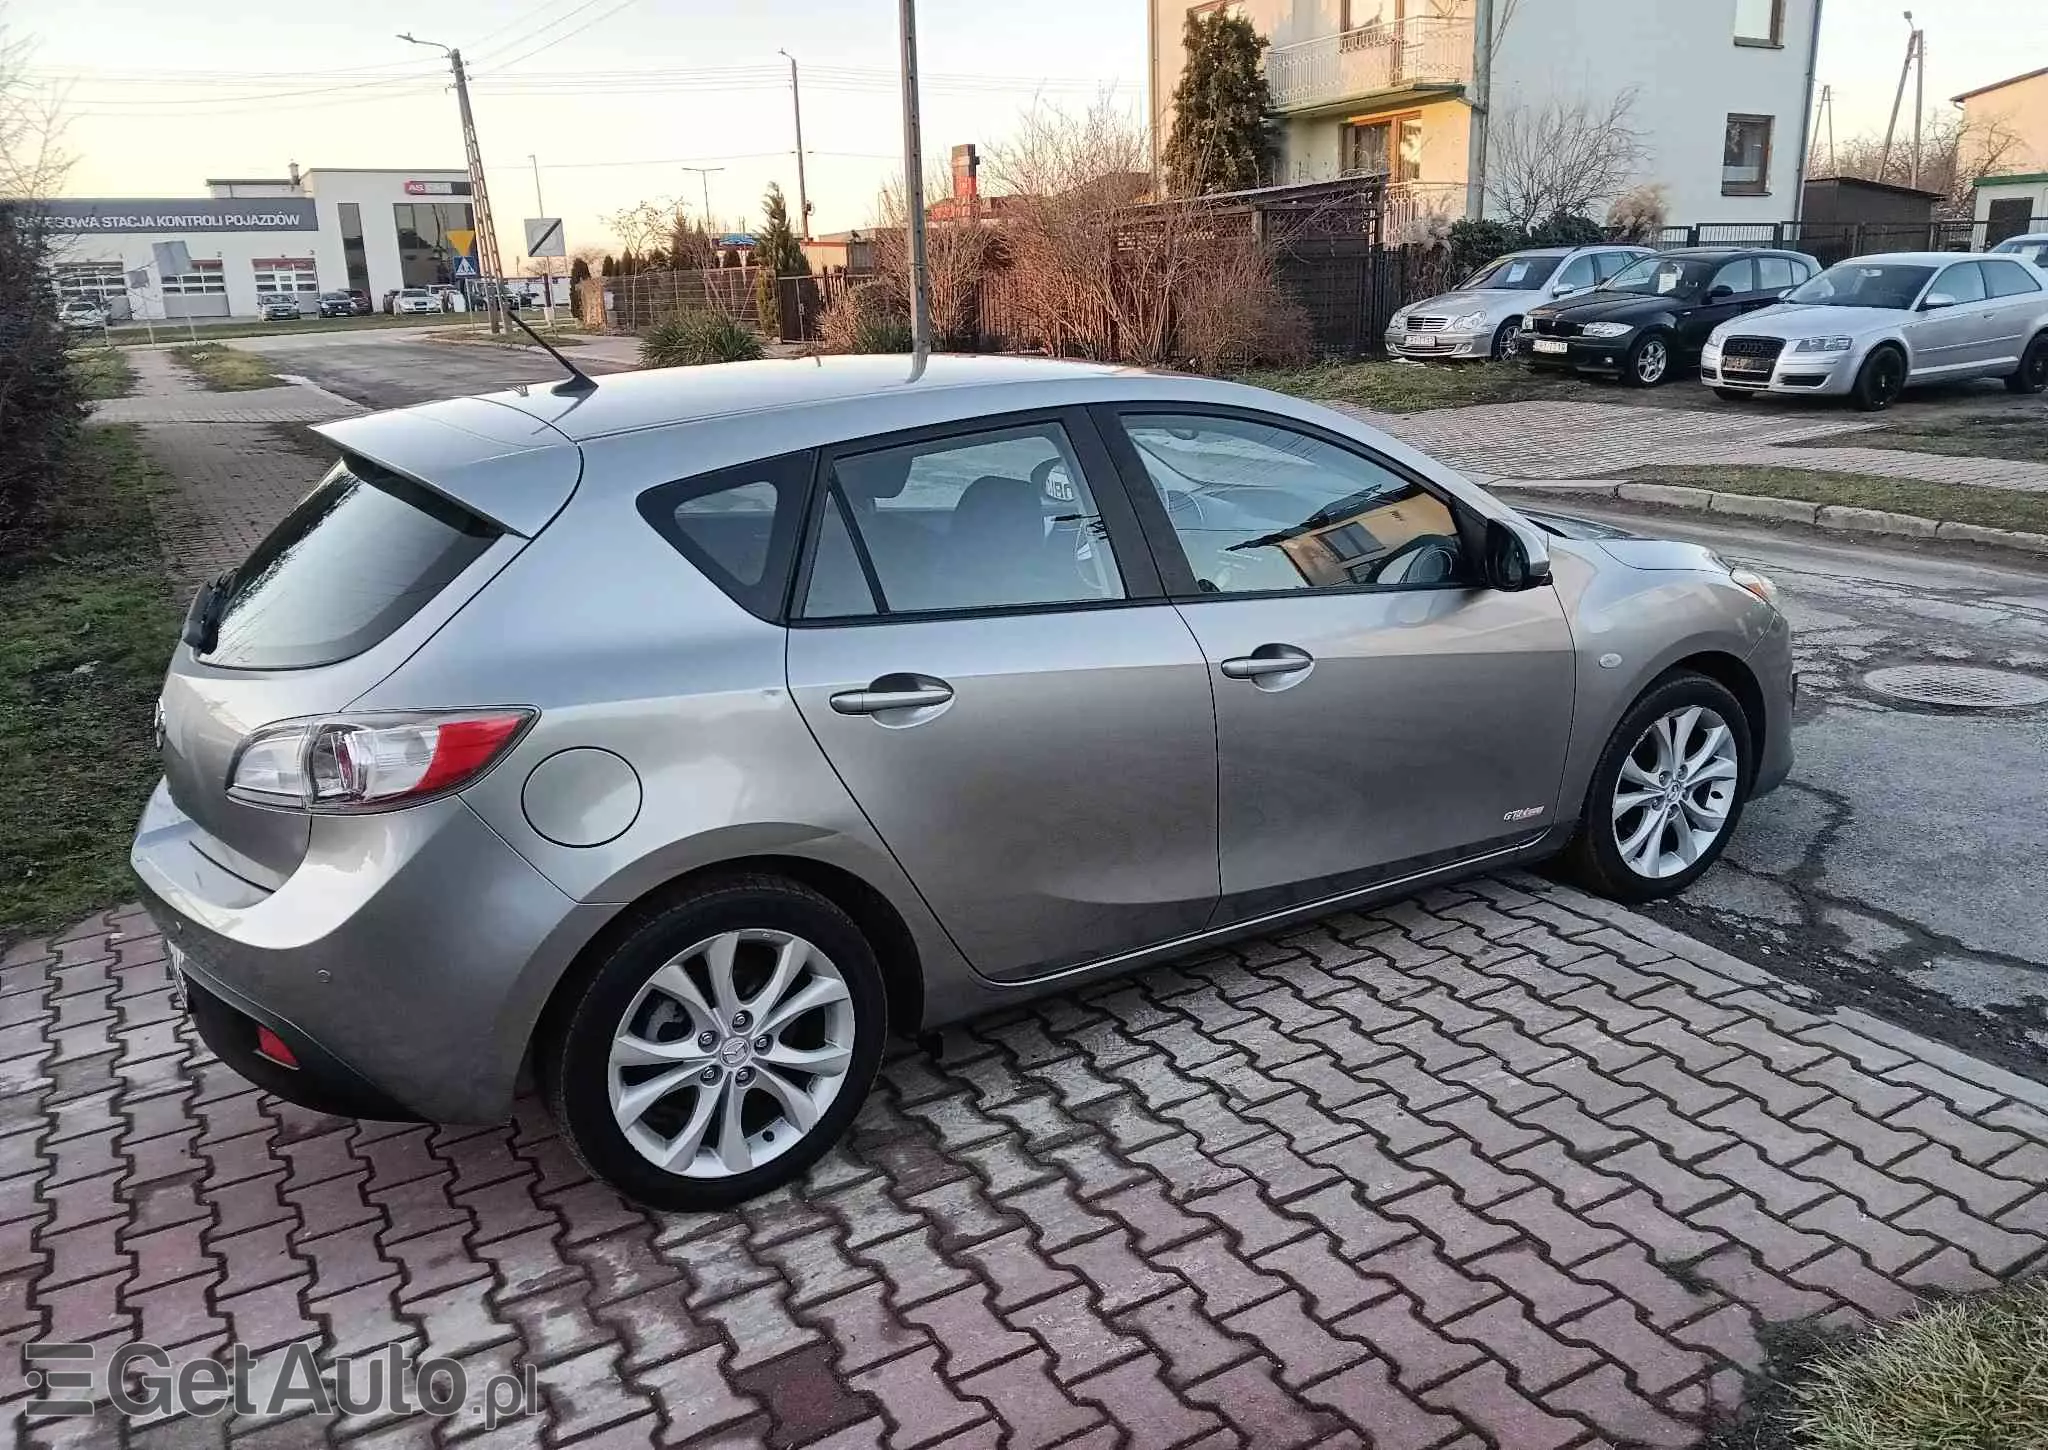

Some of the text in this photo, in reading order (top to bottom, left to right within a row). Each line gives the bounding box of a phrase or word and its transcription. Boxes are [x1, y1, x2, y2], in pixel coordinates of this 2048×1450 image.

[102, 215, 156, 228] STACJA
[157, 215, 222, 227] KONTROLI
[224, 211, 300, 226] POJAZDÓW
